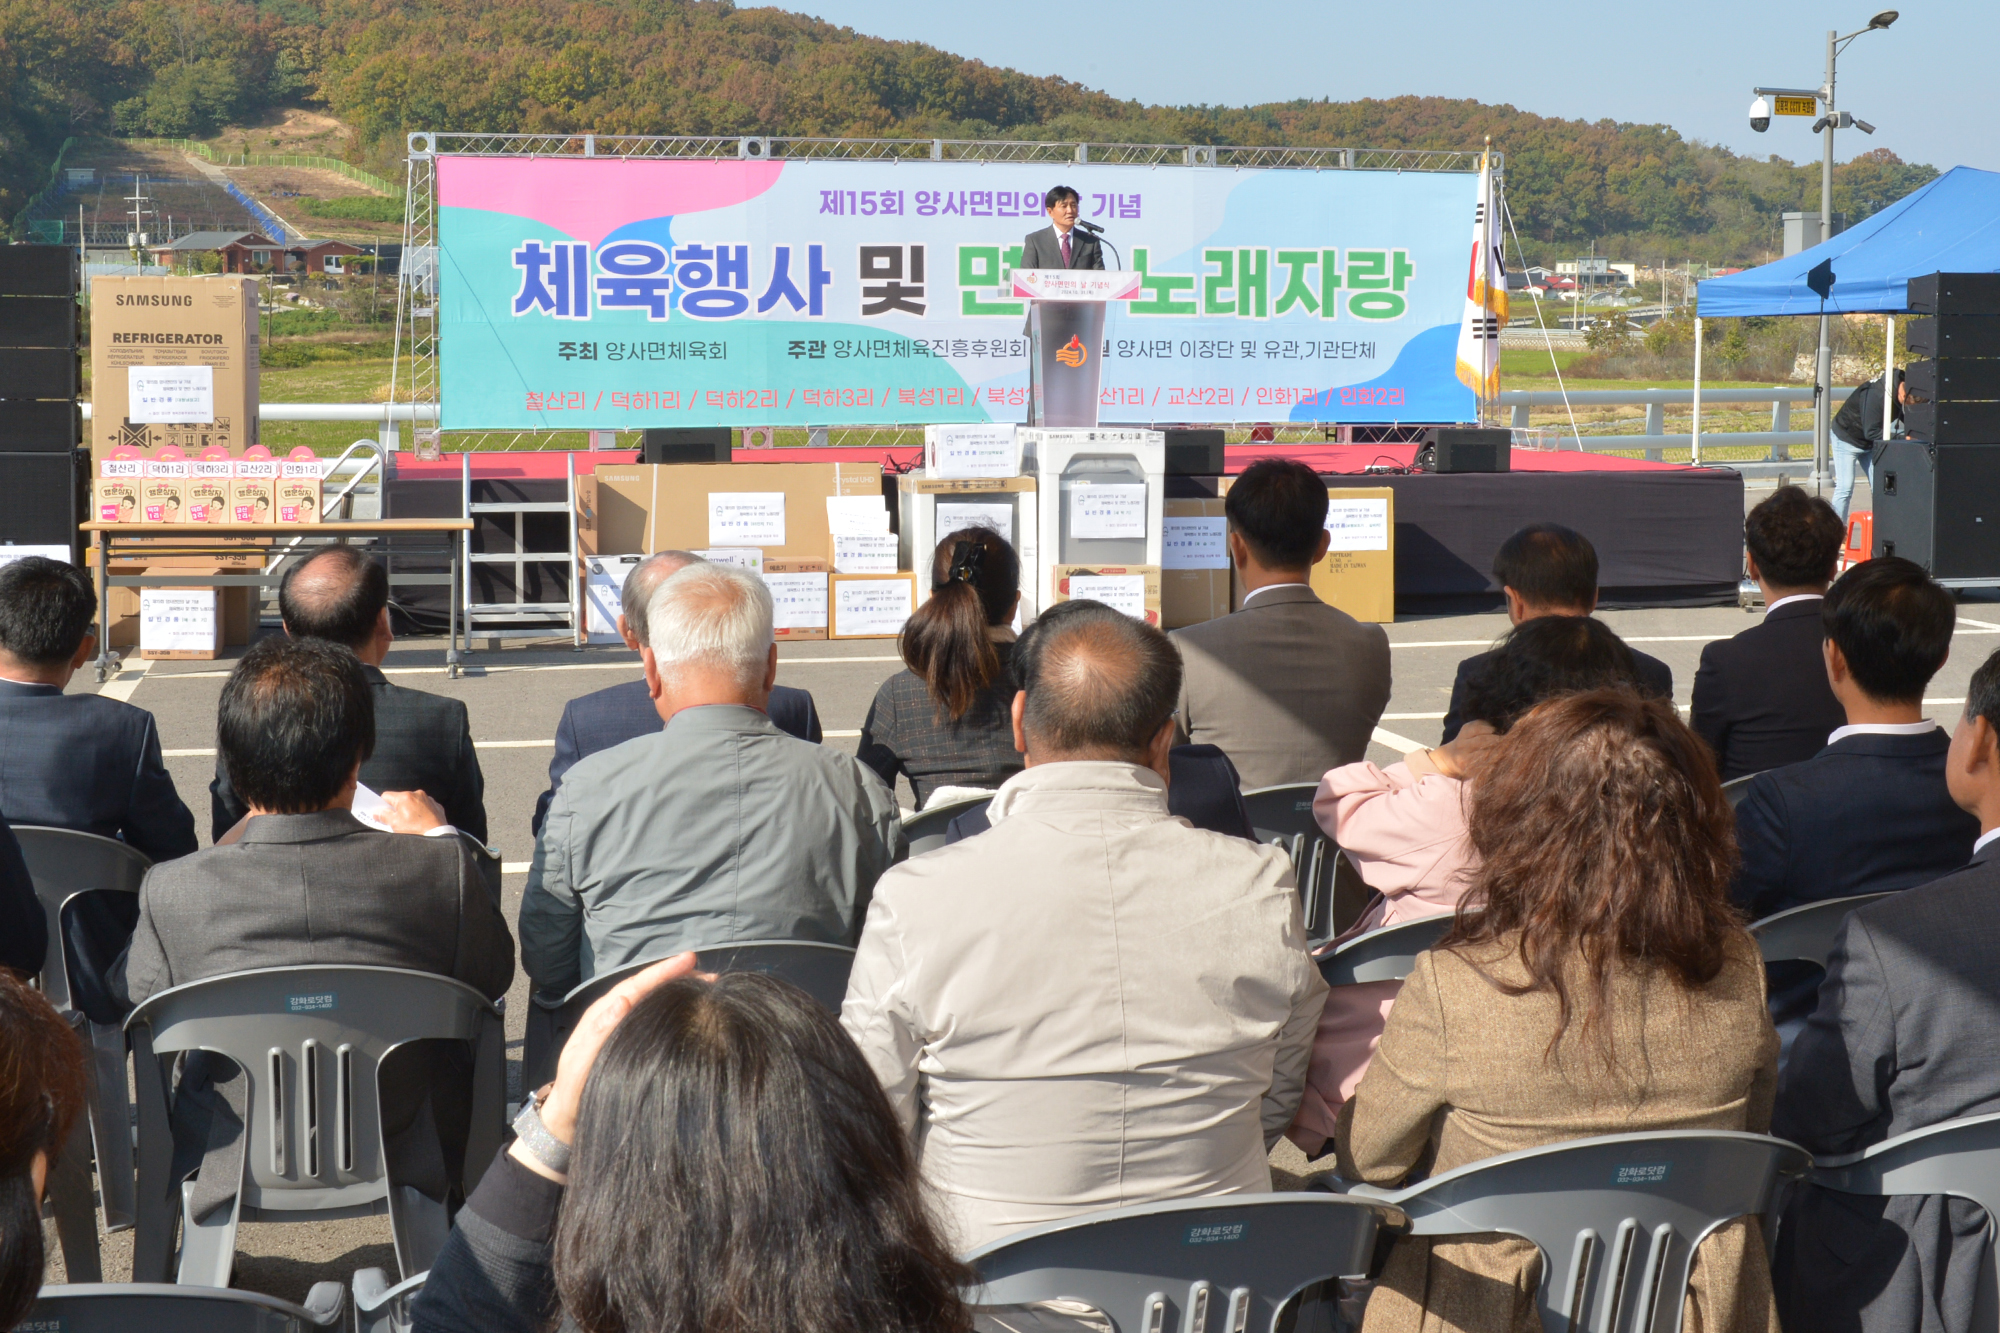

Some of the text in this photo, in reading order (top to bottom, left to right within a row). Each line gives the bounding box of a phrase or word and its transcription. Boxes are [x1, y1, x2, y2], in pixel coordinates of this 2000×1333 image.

[819, 189, 905, 216] 제15회
[914, 190, 1047, 217] 양사면민의
[1091, 193, 1142, 219] 기념
[513, 241, 1414, 319] 체육행사 및 면 노래자랑
[1044, 280, 1077, 288] 양사면민의
[1091, 281, 1110, 289] 기념식
[116, 294, 193, 307] SAMSUNG
[112, 333, 223, 345] REFRIGERATOR
[558, 341, 727, 361] 주최 양사면체육회
[787, 339, 1027, 360] 주관 양사면체육진흥후원회
[1117, 339, 1172, 358] 양사면
[1180, 340, 1234, 358] 이장단
[1241, 340, 1256, 358] 및
[1264, 340, 1376, 360] 유관,기관단체
[525, 390, 585, 410] 철산리
[611, 391, 680, 410] 덕하1리
[706, 390, 778, 409] 덕하2리
[803, 388, 874, 408] 덕하3리
[898, 387, 964, 406] 북성1리
[1100, 387, 1145, 406] 산1리
[1168, 387, 1234, 406] 교산2리
[1256, 387, 1318, 406] 인화1리
[1340, 387, 1405, 406] 인화2리
[108, 464, 136, 474] 철산리
[152, 465, 184, 474] 덕하1리
[196, 465, 228, 474] 덕하3리
[240, 464, 272, 474] 교산2리
[286, 465, 318, 474] 인화1리
[290, 994, 332, 1006] 강화로닷컴
[291, 1002, 332, 1010] 032-934-1400
[1618, 1165, 1666, 1176] 강화로닷컴
[1617, 1174, 1663, 1182] 032-934-1400
[1190, 1224, 1243, 1237] 강화로닷컴
[1189, 1234, 1240, 1243] 032-934-1400
